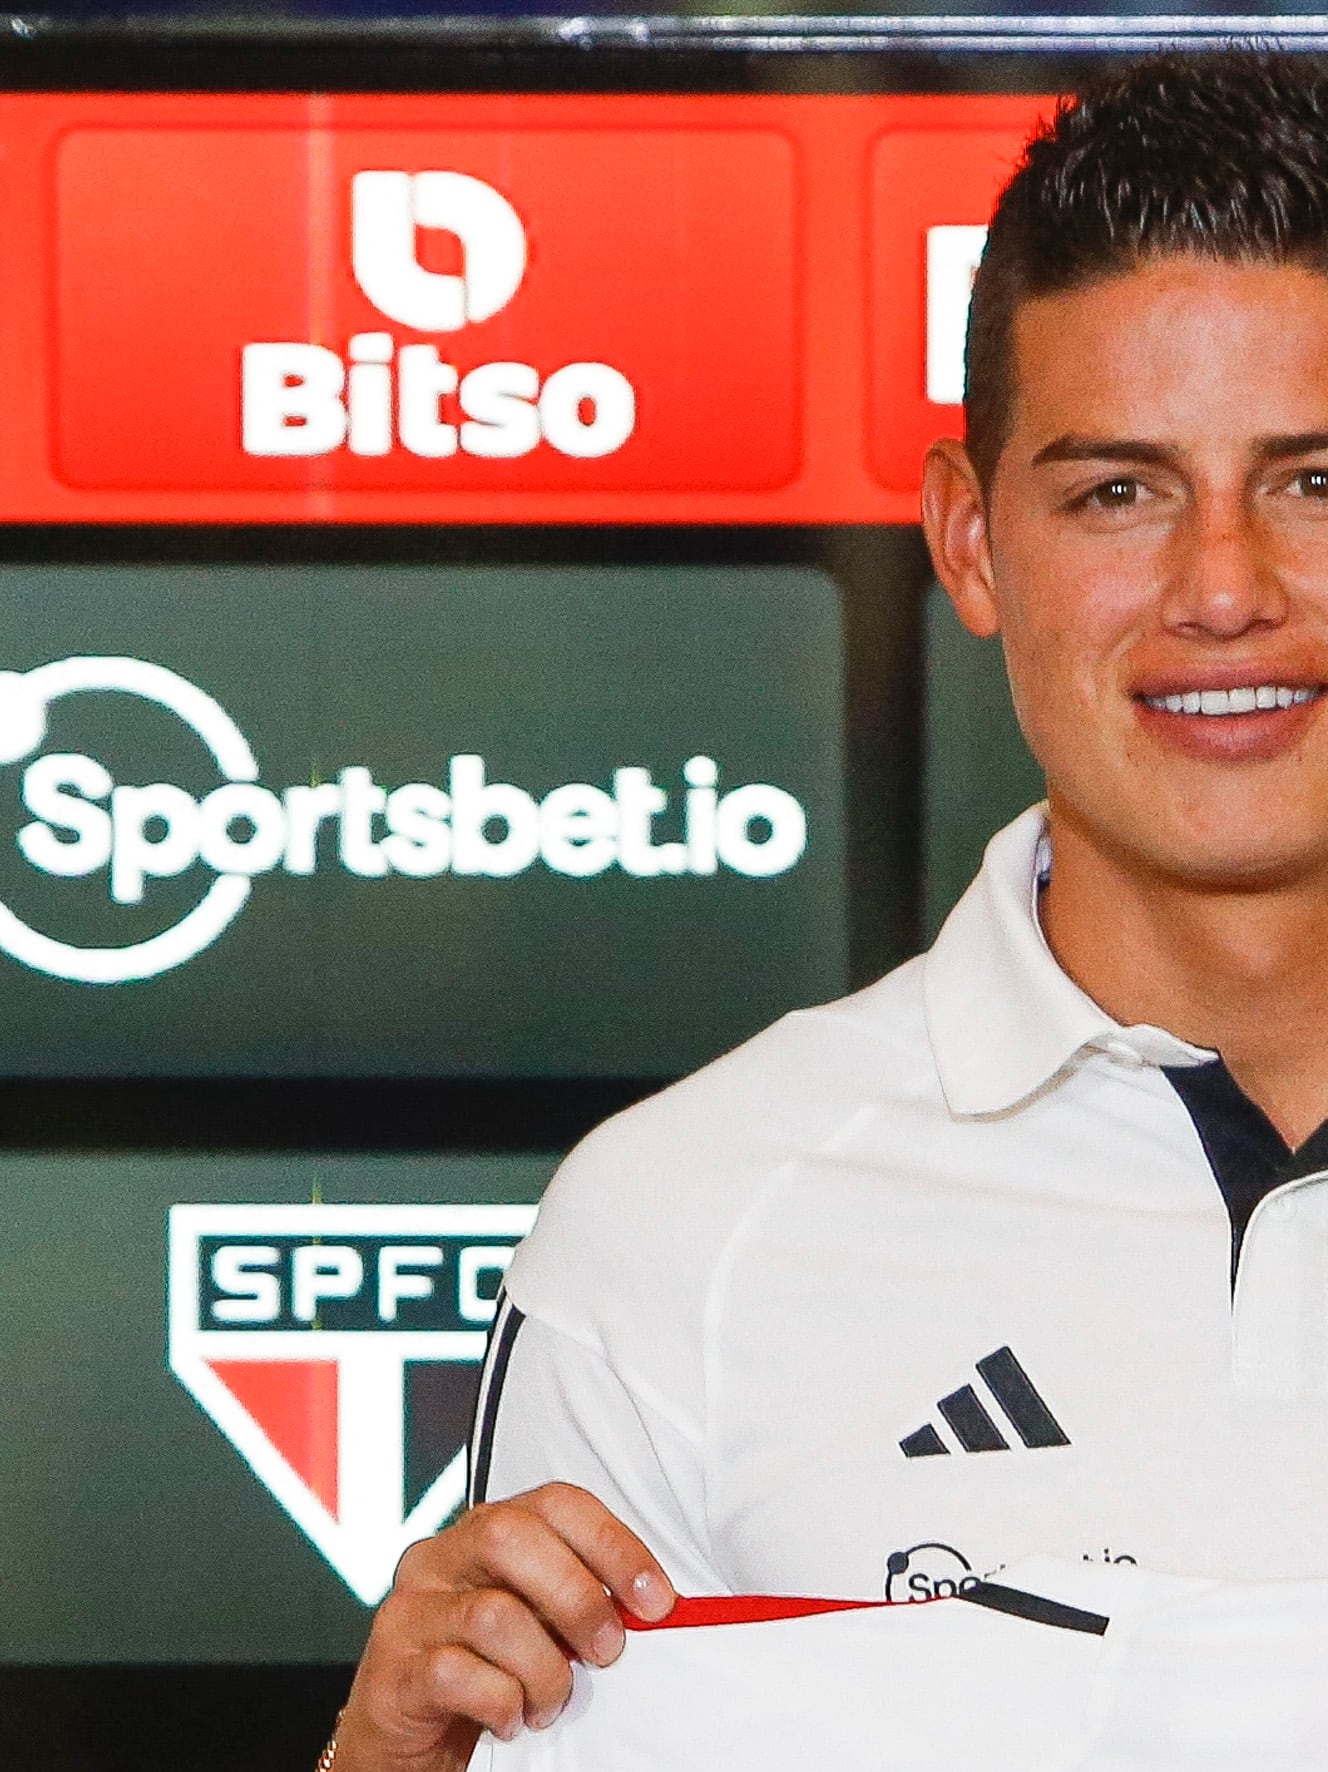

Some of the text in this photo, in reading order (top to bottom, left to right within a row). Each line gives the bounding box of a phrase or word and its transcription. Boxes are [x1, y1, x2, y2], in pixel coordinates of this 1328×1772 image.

[241, 332, 636, 458] Bitso
[16, 754, 806, 904] Sportsbet.io
[212, 1245, 516, 1322] SPFC
